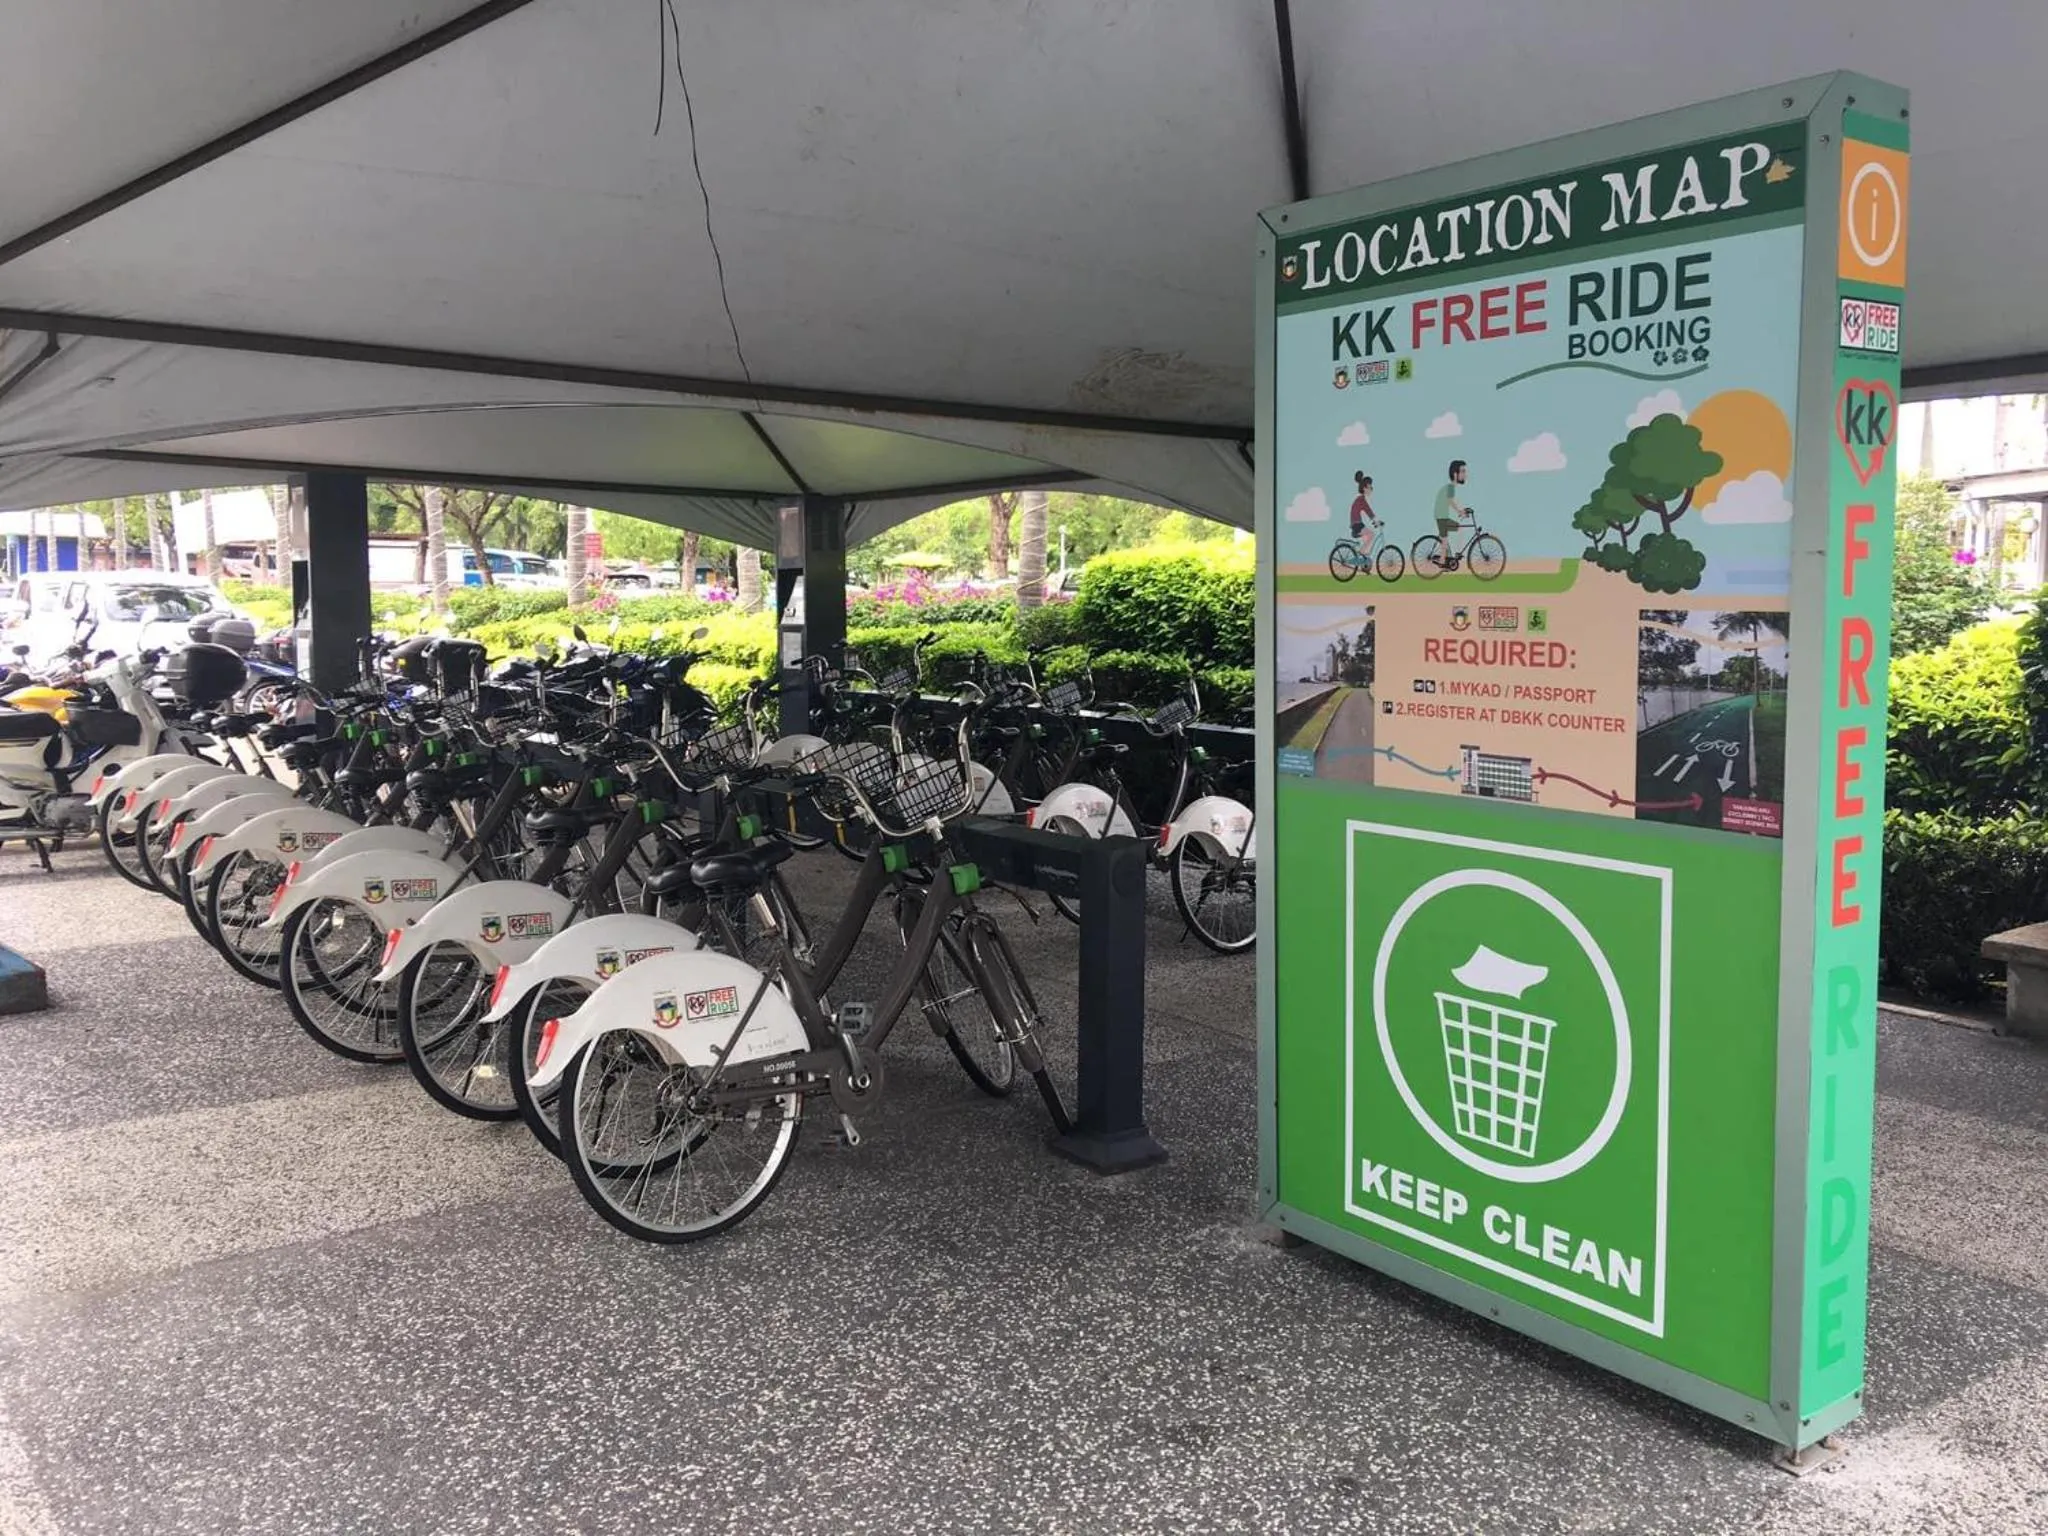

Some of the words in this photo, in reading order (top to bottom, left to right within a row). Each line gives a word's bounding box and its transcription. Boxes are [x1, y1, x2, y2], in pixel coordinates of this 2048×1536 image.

[1300, 181, 1578, 289] LOCATION
[1600, 143, 1770, 231] MAP
[1332, 306, 1396, 361] KK
[1412, 280, 1547, 349] FREE
[1569, 252, 1712, 326] RIDE
[1868, 304, 1897, 328] FREE
[1568, 315, 1712, 360] BOOKING
[1867, 326, 1896, 349] RIDE
[1424, 638, 1577, 669] REQUIRED:
[1440, 681, 1501, 698] 1.MYKAD
[1513, 685, 1597, 704] PASSPORT
[1396, 702, 1476, 721] 2.REGISTER
[1479, 708, 1497, 722] AT
[1501, 709, 1543, 726] DBKK
[1547, 713, 1626, 732] COUNTER
[1832, 504, 1876, 928] FREE
[709, 989, 734, 1002] FREE
[710, 1000, 736, 1014] RIDE
[1361, 1158, 1468, 1224] KEEP
[1483, 1205, 1642, 1297] CLEAN
